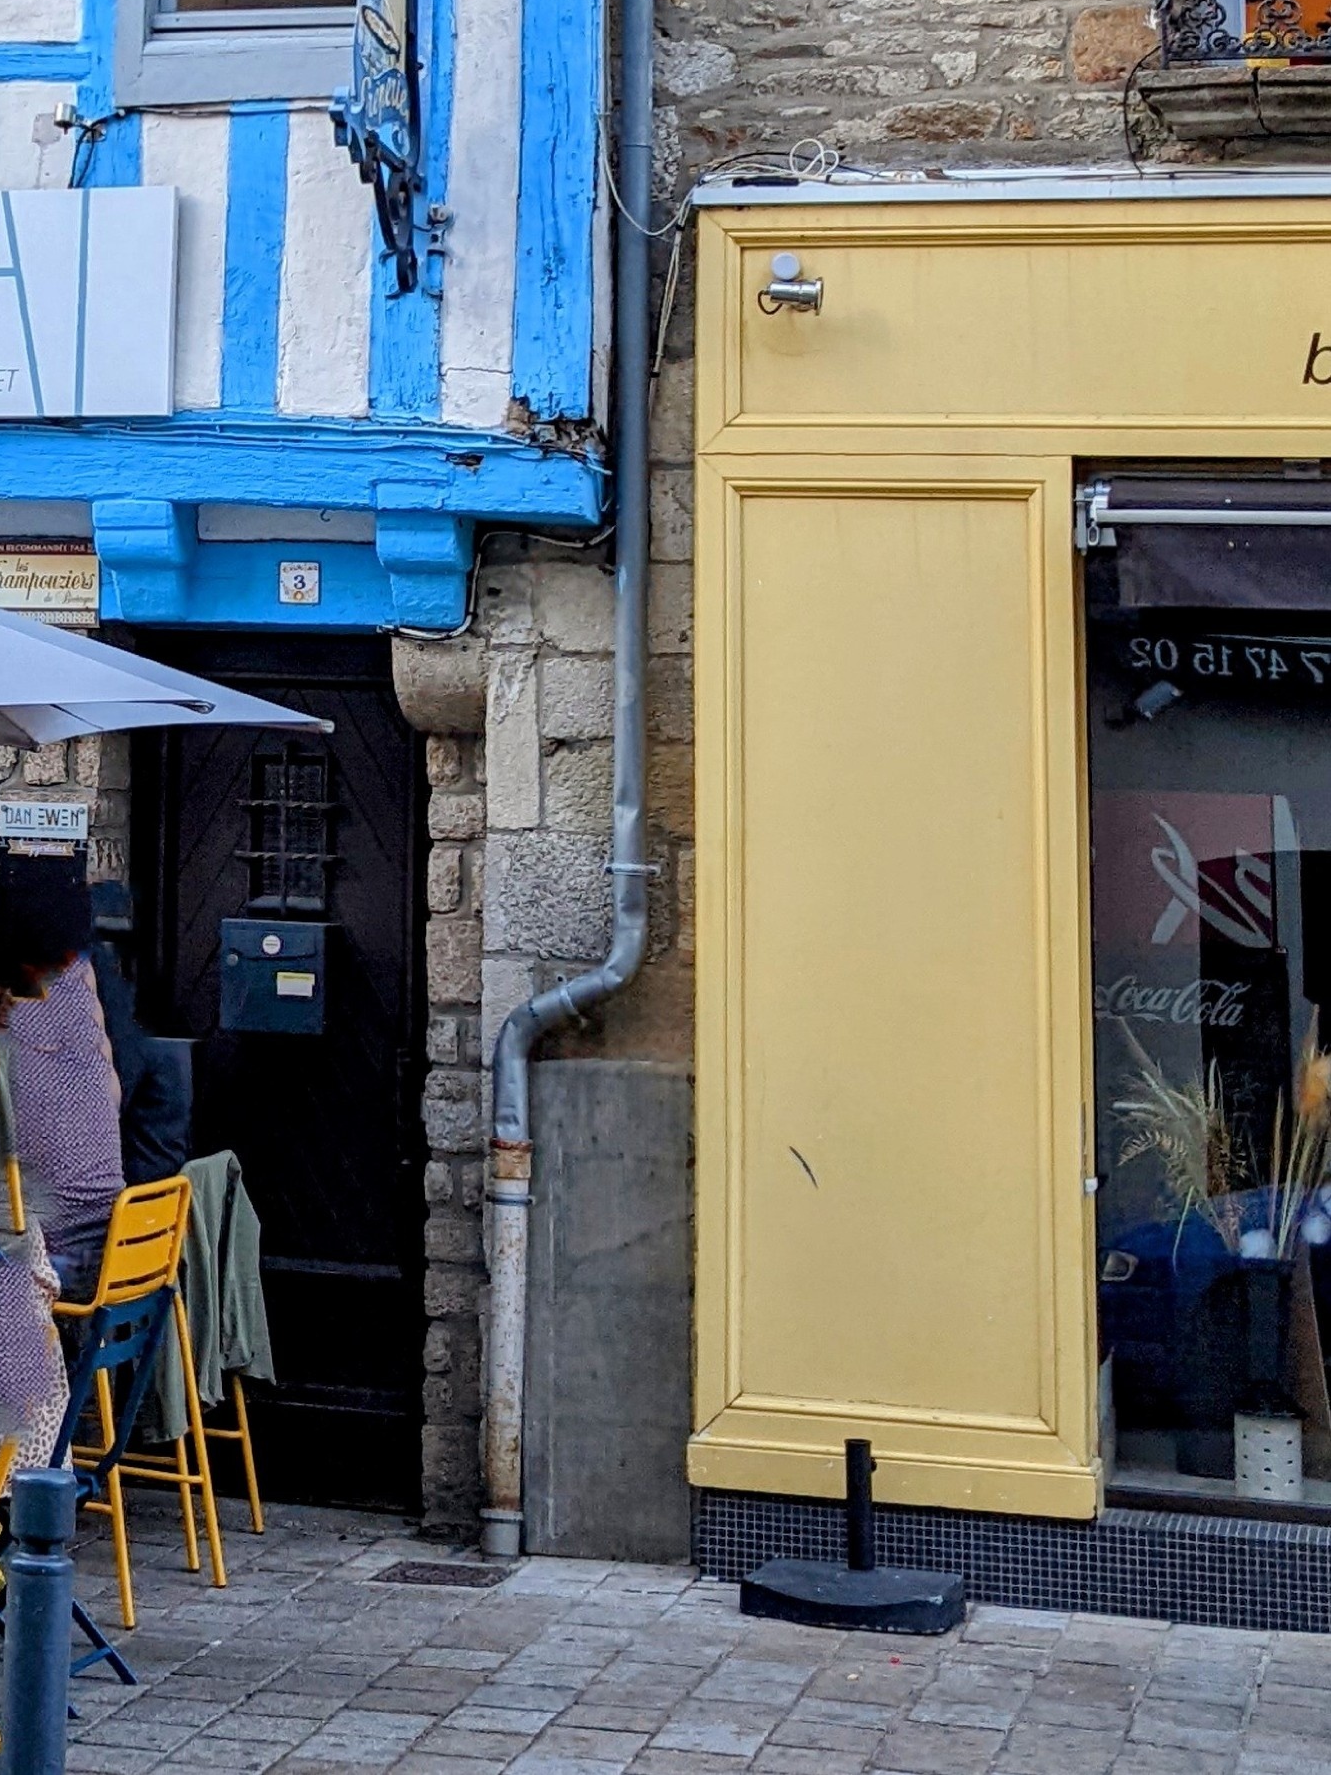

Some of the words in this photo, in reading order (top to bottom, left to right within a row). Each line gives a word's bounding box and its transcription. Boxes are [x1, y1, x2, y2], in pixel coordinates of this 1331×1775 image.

[293, 575, 306, 590] 3
[5, 807, 32, 824] DAN
[38, 808, 79, 827] EWEN
